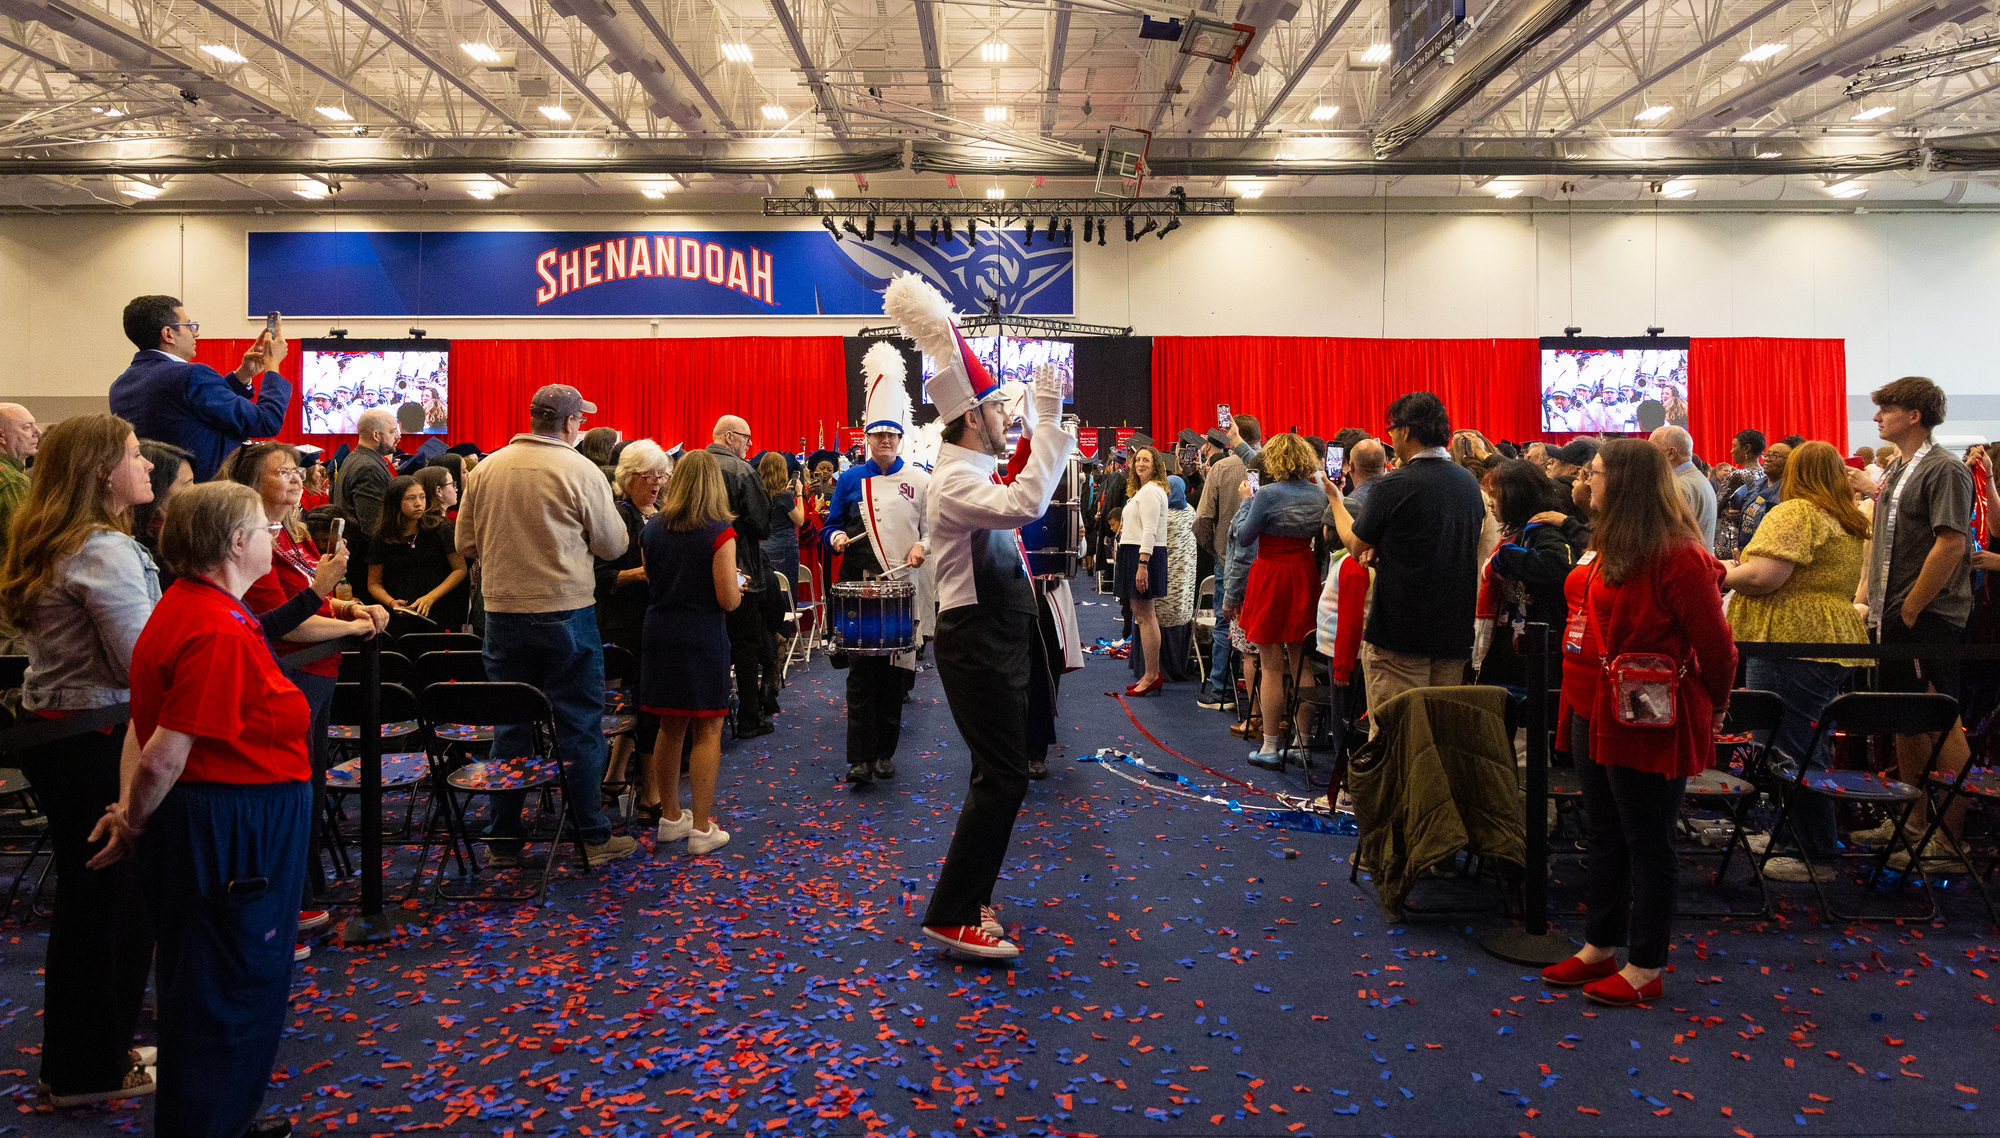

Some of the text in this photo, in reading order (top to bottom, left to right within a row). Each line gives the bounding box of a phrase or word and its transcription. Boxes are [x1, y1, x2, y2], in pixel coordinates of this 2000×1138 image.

[1406, 63, 1417, 79] We're
[1417, 56, 1425, 68] The
[1425, 45, 1435, 62] Bank
[1442, 30, 1453, 45] That.
[536, 235, 774, 307] SHENANDOAH
[899, 482, 914, 499] SU
[1569, 631, 1583, 639] STAFF
